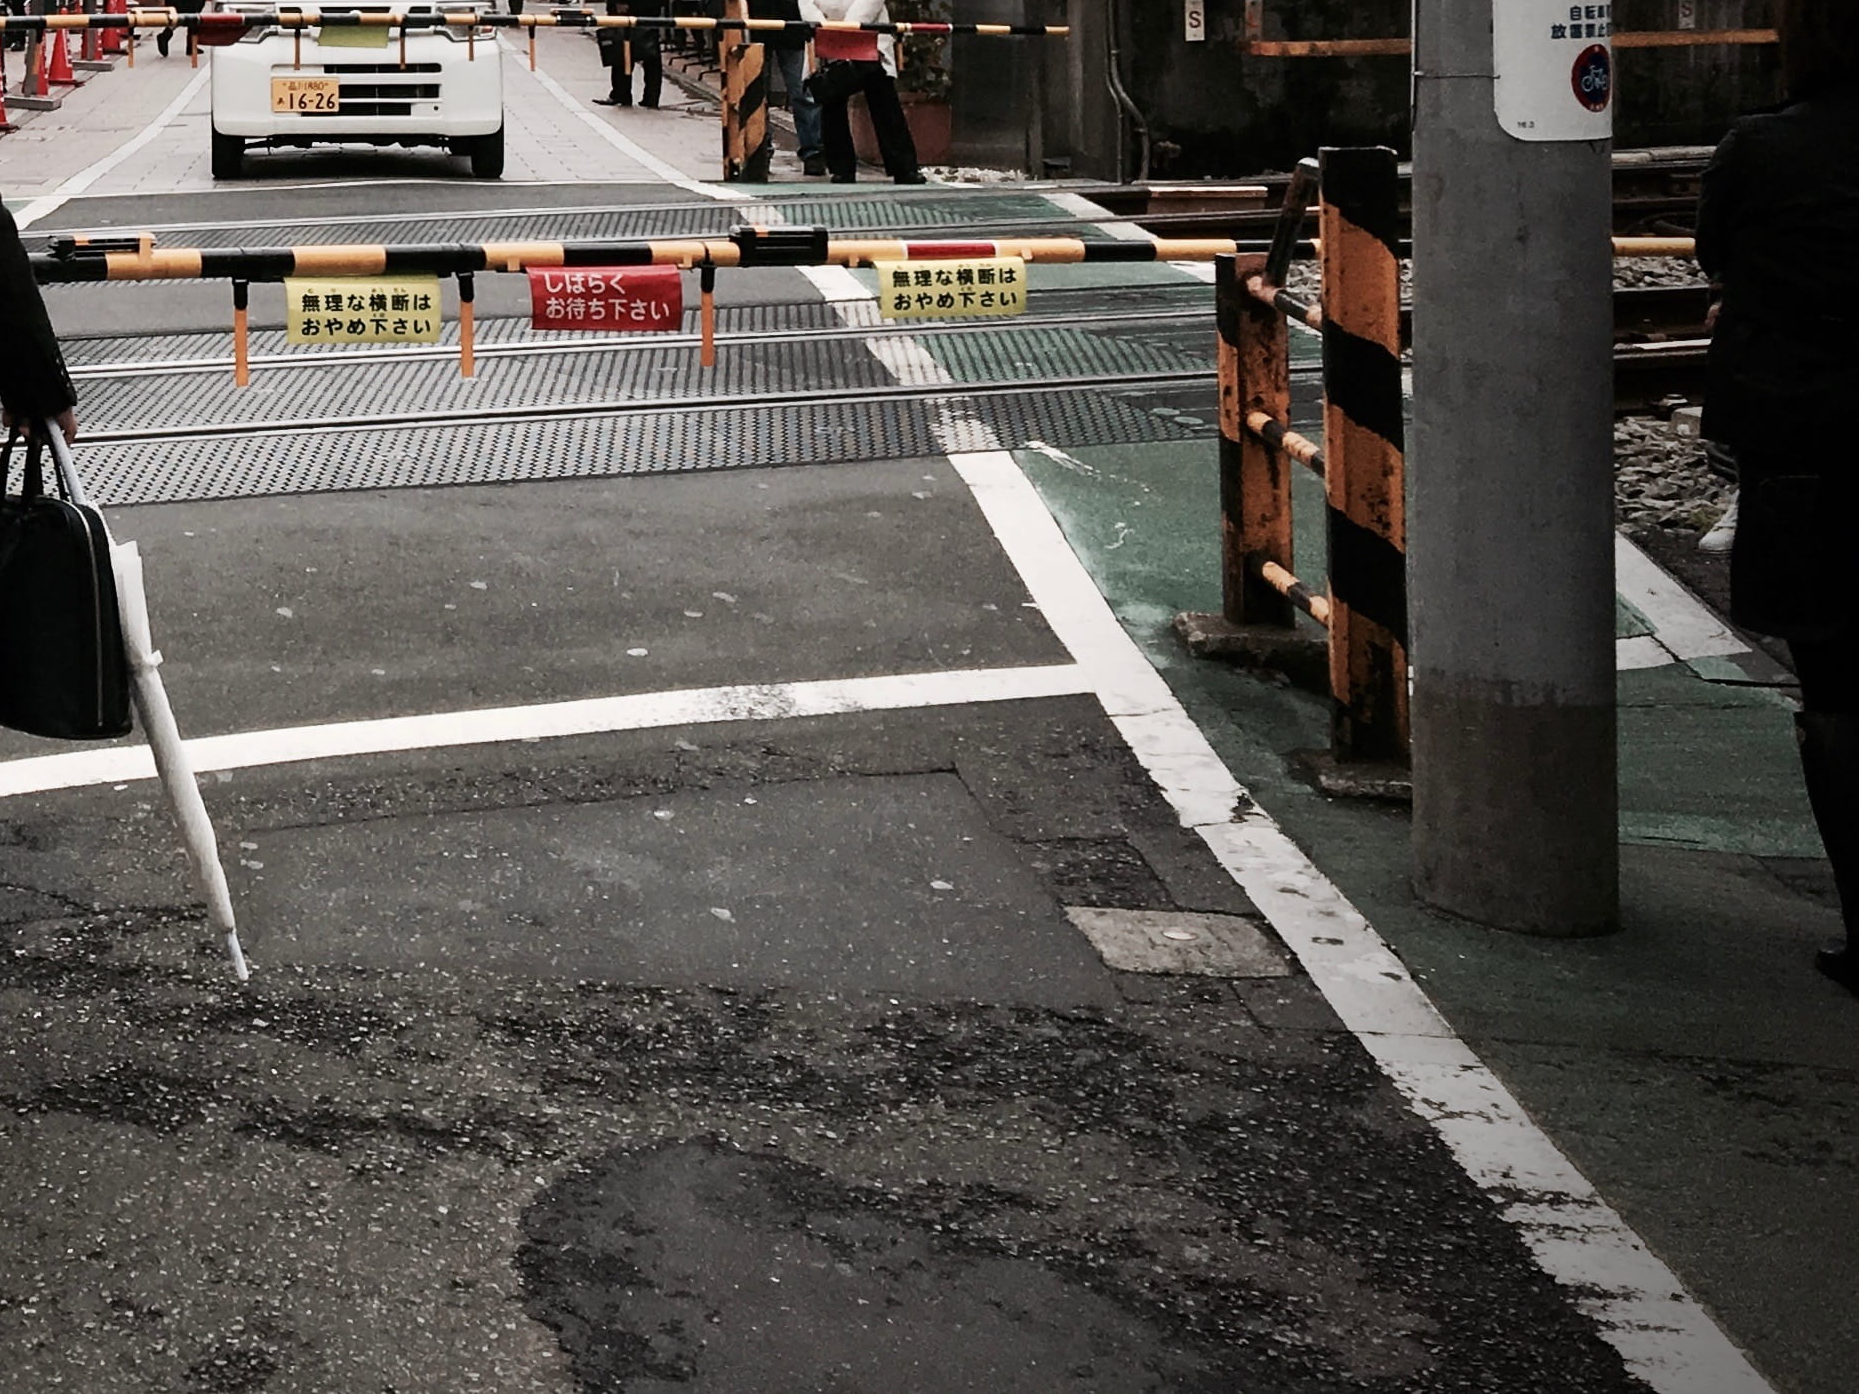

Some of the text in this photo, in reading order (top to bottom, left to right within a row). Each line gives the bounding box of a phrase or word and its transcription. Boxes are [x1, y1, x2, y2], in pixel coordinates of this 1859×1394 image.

[1189, 10, 1202, 28] S
[289, 92, 336, 110] 16-26
[543, 272, 626, 294] しばらく
[892, 267, 1017, 288] 無理な横断は
[301, 293, 432, 313] 無理な横断は
[545, 297, 670, 321] お待ち下さい
[893, 290, 1018, 311] おやめ下さい
[301, 317, 431, 336] おやめ下さい
